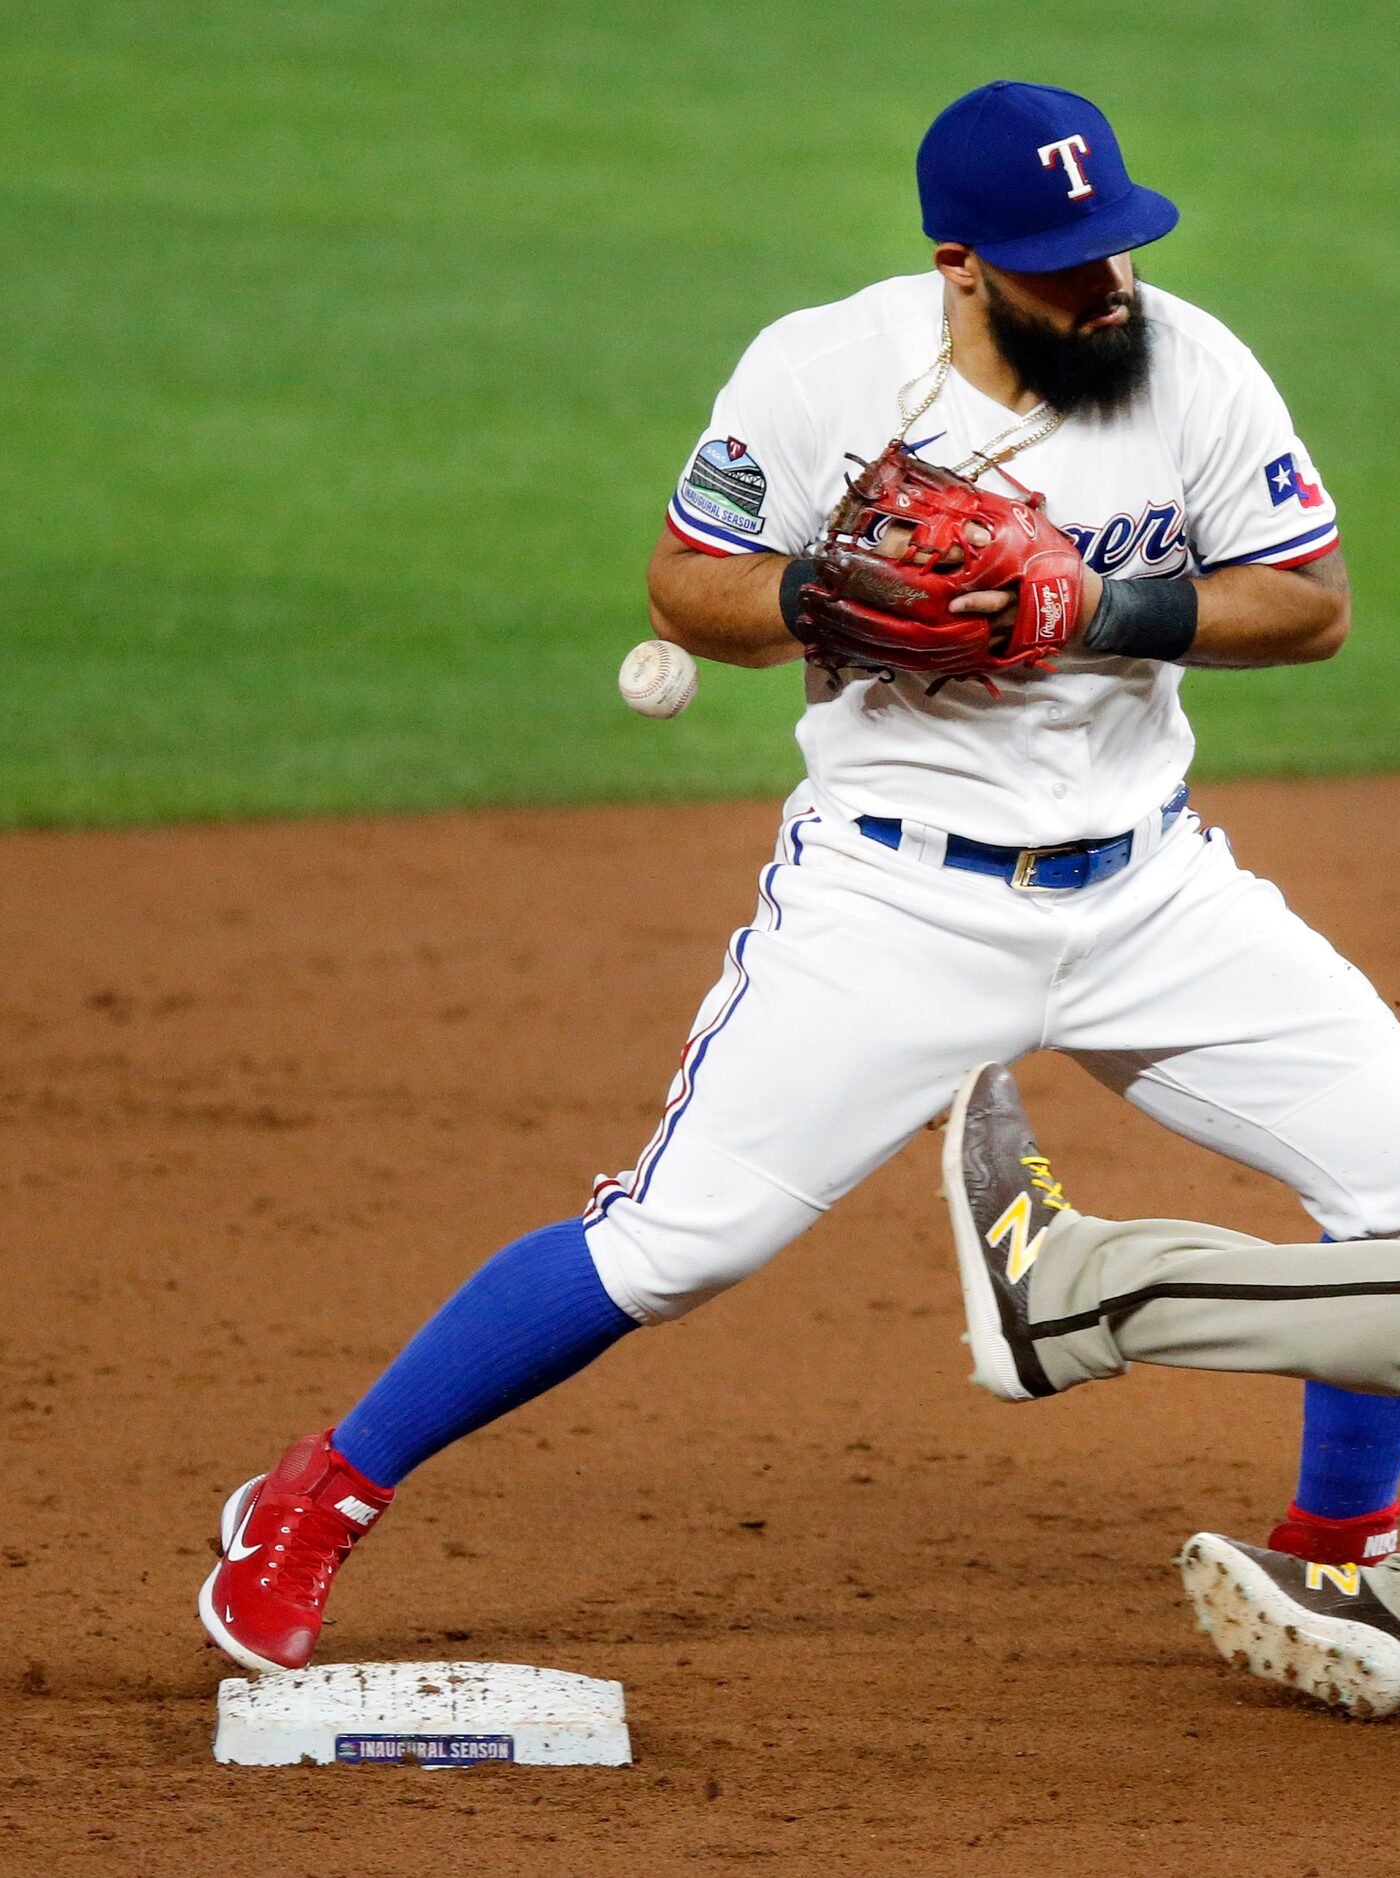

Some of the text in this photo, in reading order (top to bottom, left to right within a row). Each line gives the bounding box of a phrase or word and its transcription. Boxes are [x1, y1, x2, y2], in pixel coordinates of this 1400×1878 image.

[1037, 133, 1095, 202] T
[730, 441, 741, 457] T
[685, 488, 758, 531] INAUGURAL SEASON
[1039, 584, 1063, 639] Rawlings
[333, 1494, 380, 1527] NIKE
[449, 1741, 510, 1759] SEASON
